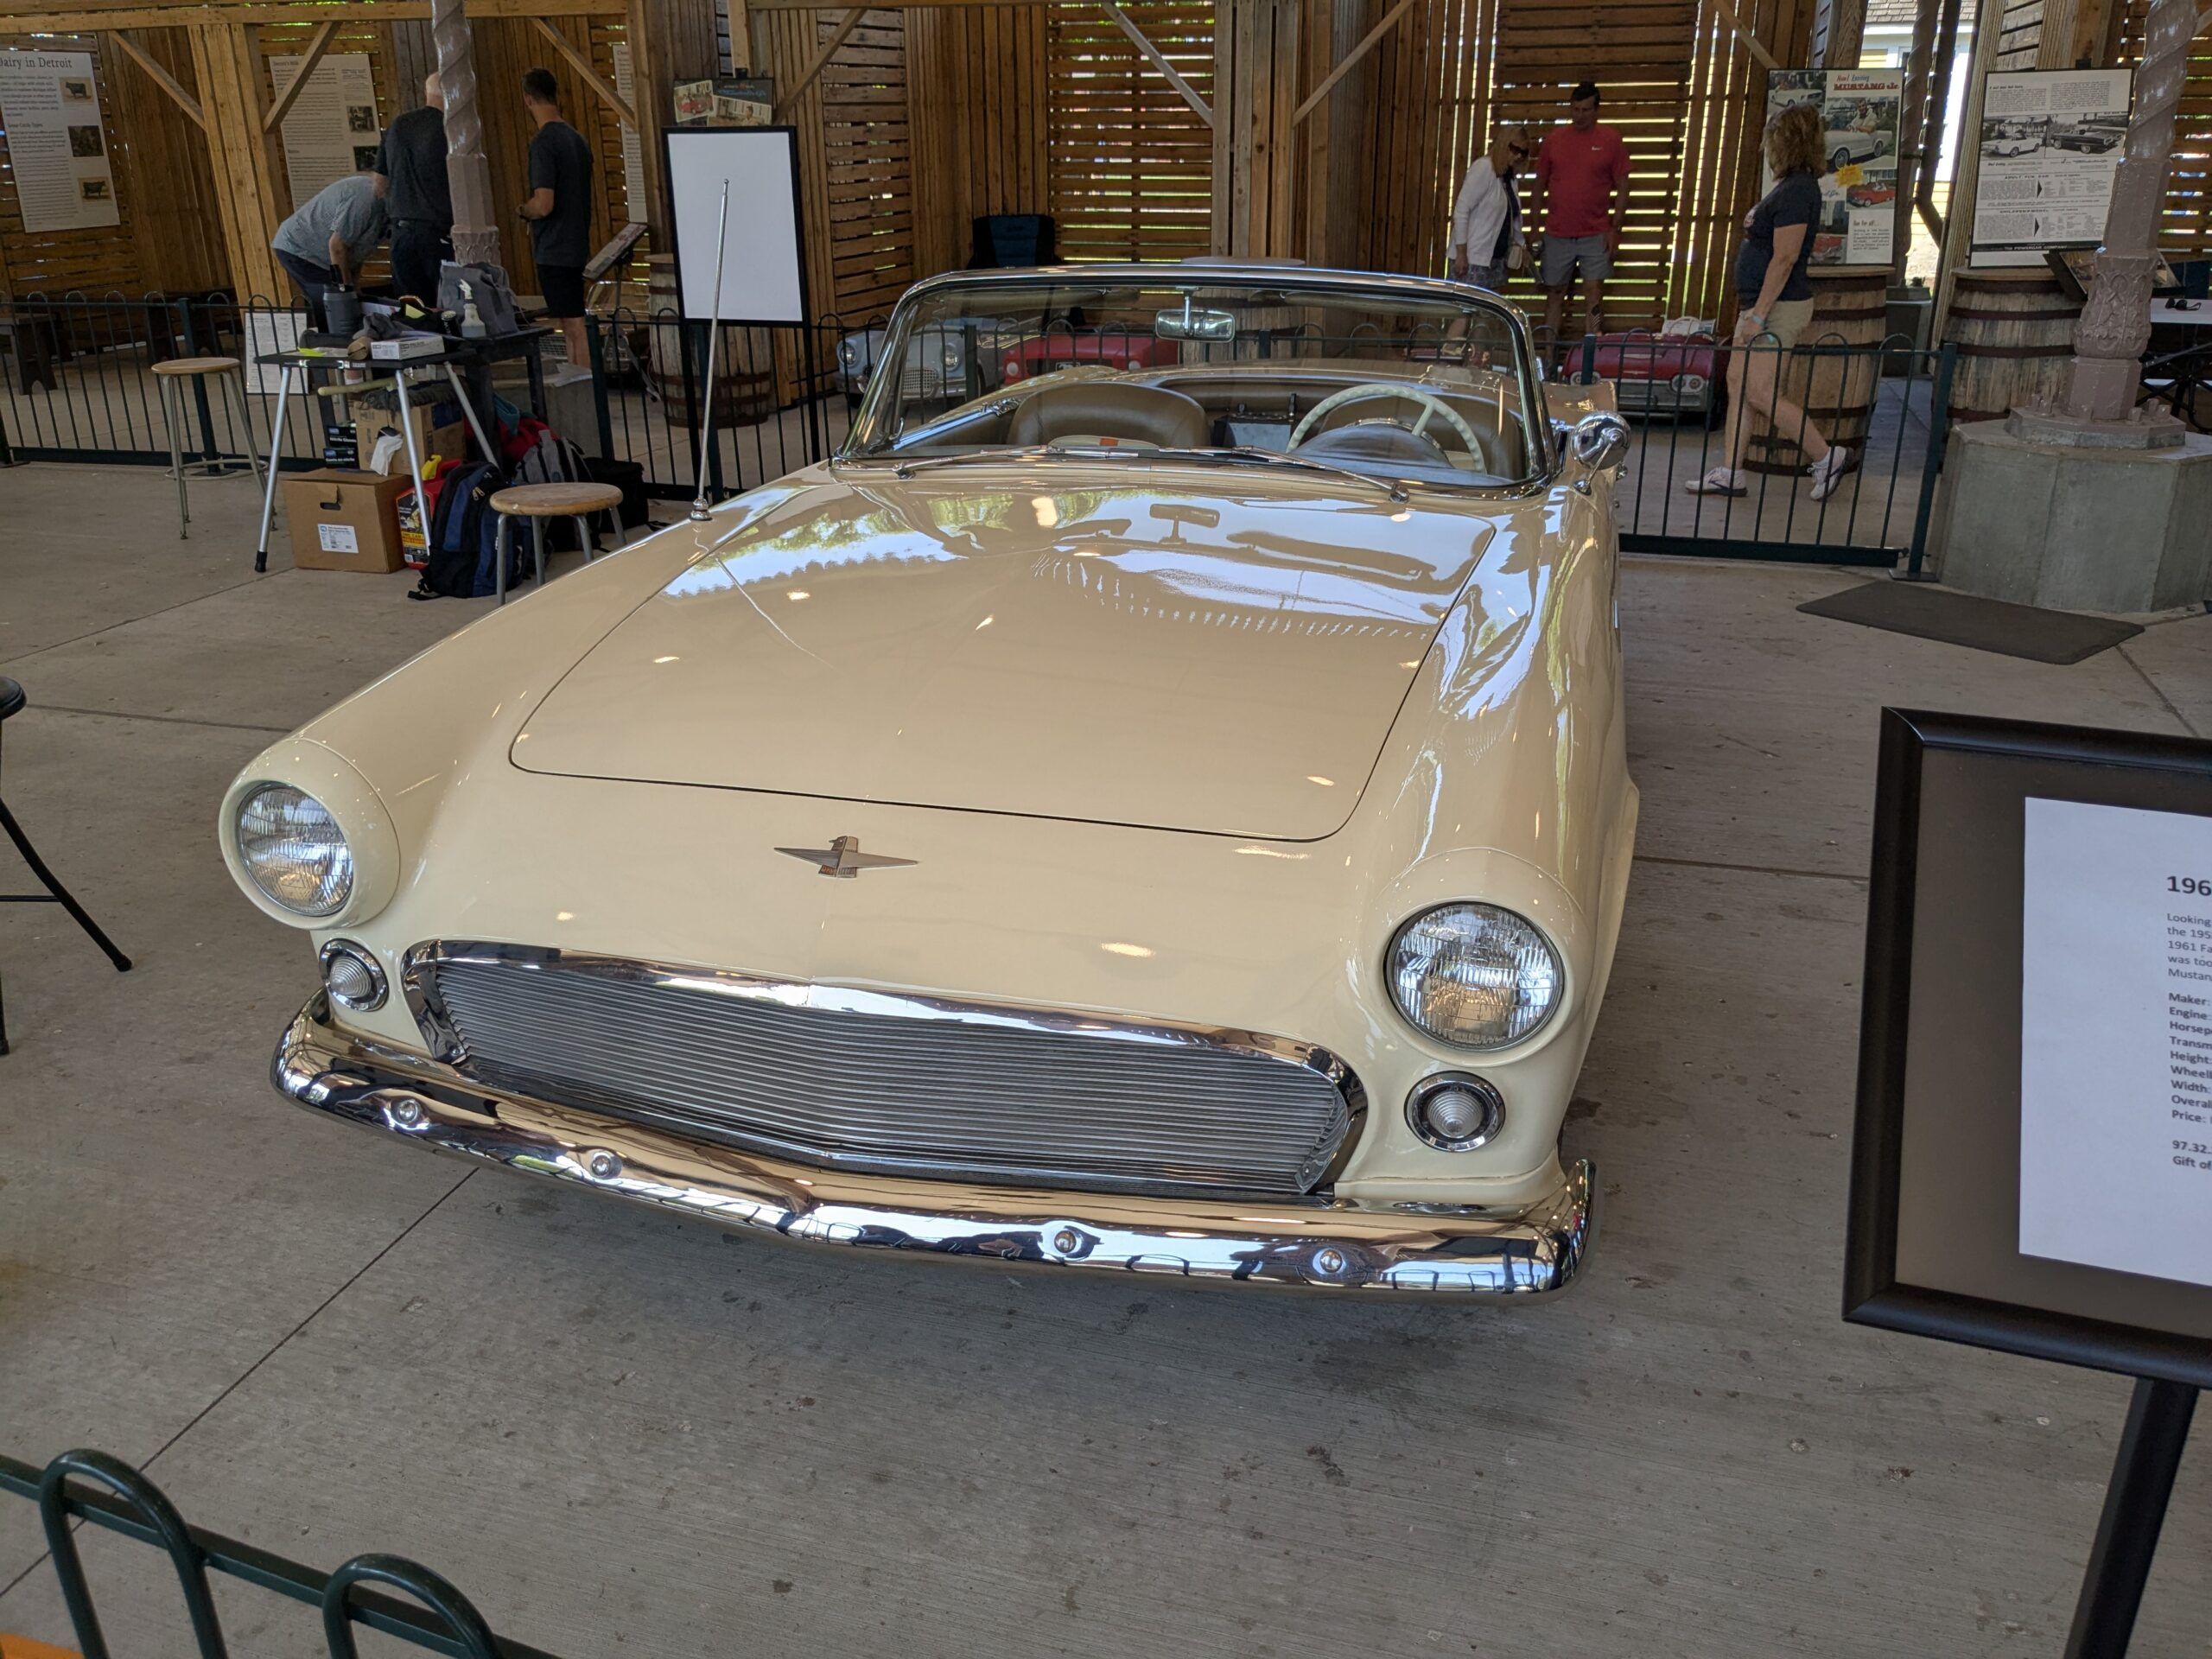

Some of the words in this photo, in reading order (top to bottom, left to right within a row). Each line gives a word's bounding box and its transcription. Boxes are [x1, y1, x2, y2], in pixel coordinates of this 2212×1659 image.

[25, 56, 35, 67] in
[38, 56, 73, 68] Detroit
[1834, 82, 1885, 91] MUSTANG
[2167, 875, 2212, 897] 196
[2167, 912, 2212, 927] Looking
[2167, 926, 2186, 937] the
[2168, 940, 2197, 951] 1961
[2167, 956, 2190, 965] was
[2170, 1020, 2212, 1036] Horsep
[2171, 1109, 2207, 1123] Price:
[2172, 1155, 2196, 1168] Gift
